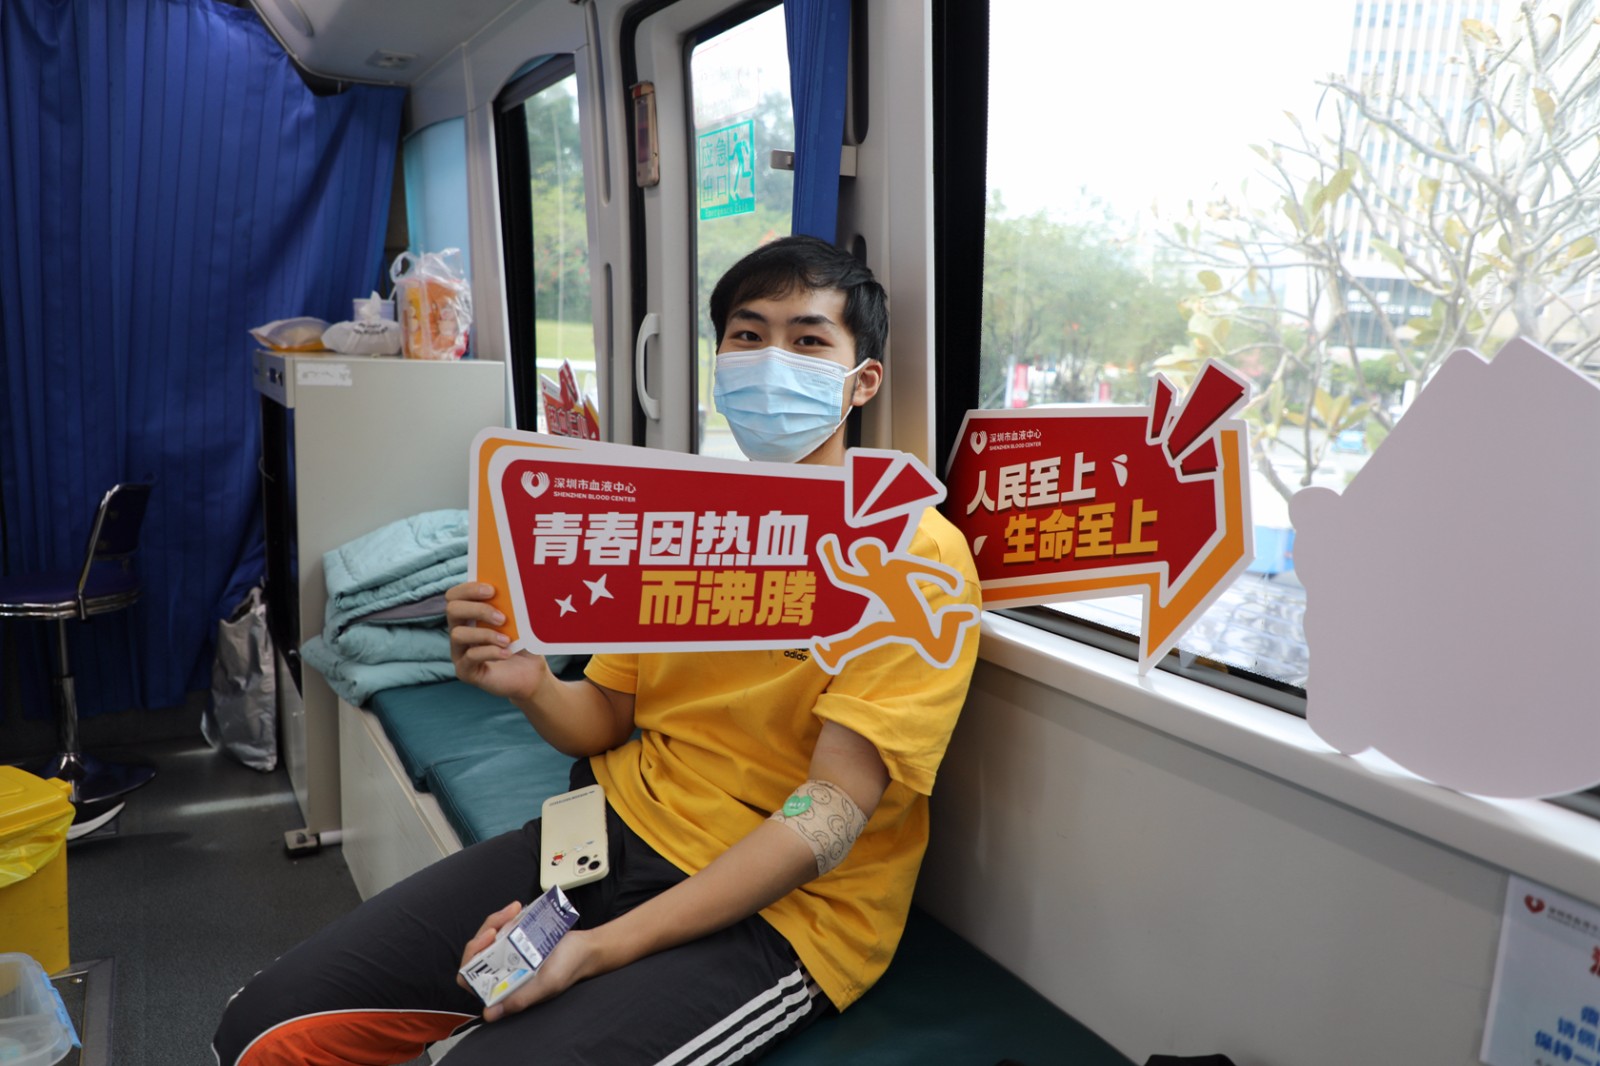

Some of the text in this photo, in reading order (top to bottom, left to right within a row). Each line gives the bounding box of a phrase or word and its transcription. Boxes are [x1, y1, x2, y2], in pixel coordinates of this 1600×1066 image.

[702, 138, 727, 169] 应急
[703, 175, 727, 202] 出口
[990, 429, 1041, 443] 深圳市血液中心
[554, 478, 636, 493] 深圳市血液中心
[966, 452, 1096, 515] 人民至上
[532, 510, 810, 566] 青春因热血
[1003, 498, 1158, 563] 生命至上
[638, 570, 817, 627] 而沸腾
[784, 651, 808, 661] adida
